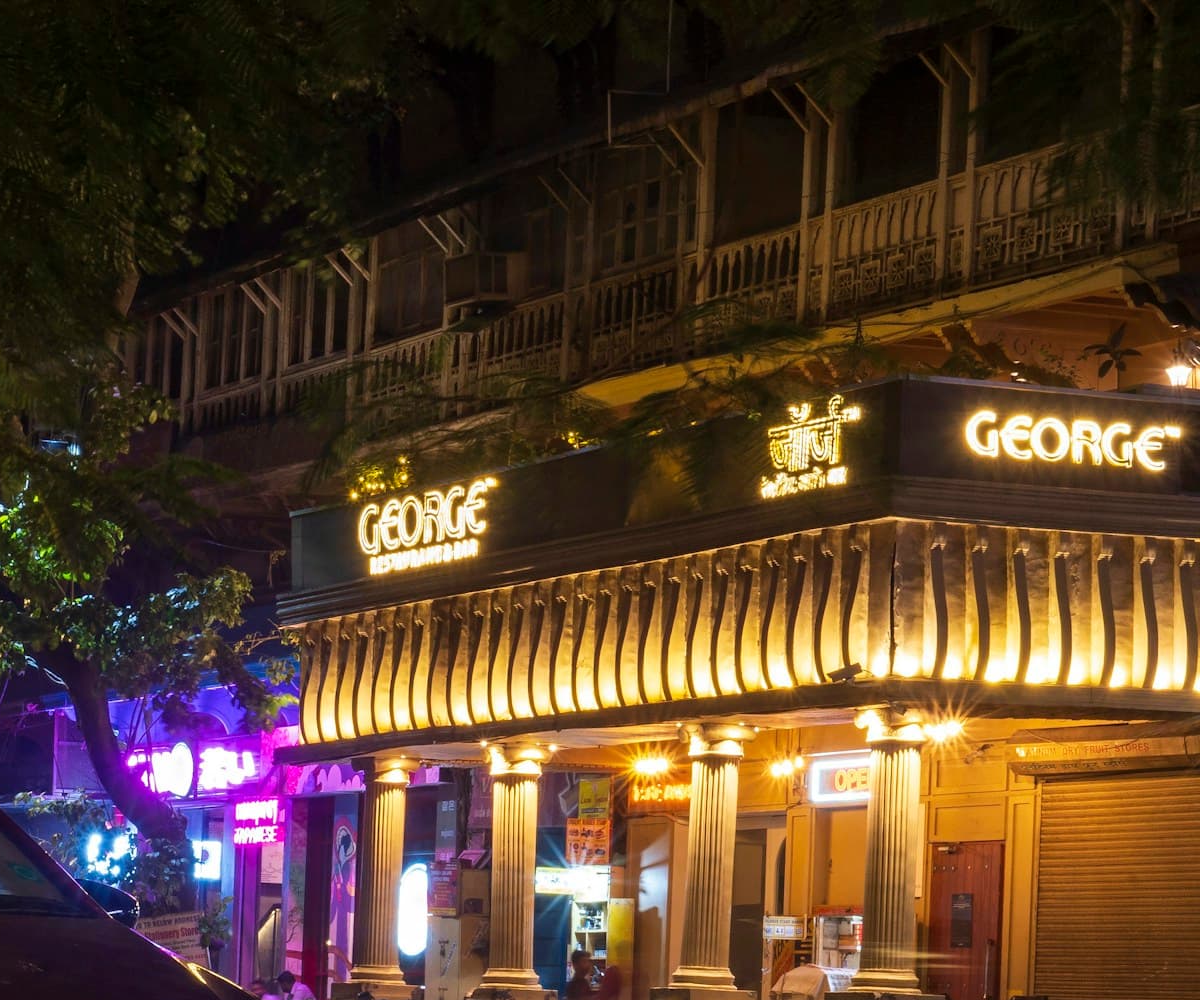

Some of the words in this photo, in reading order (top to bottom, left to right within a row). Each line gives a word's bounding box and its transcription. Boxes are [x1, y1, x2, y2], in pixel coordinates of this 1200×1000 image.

[965, 410, 1165, 471] GEORGE
[359, 481, 487, 555] GEORGE
[834, 767, 871, 792] OPE
